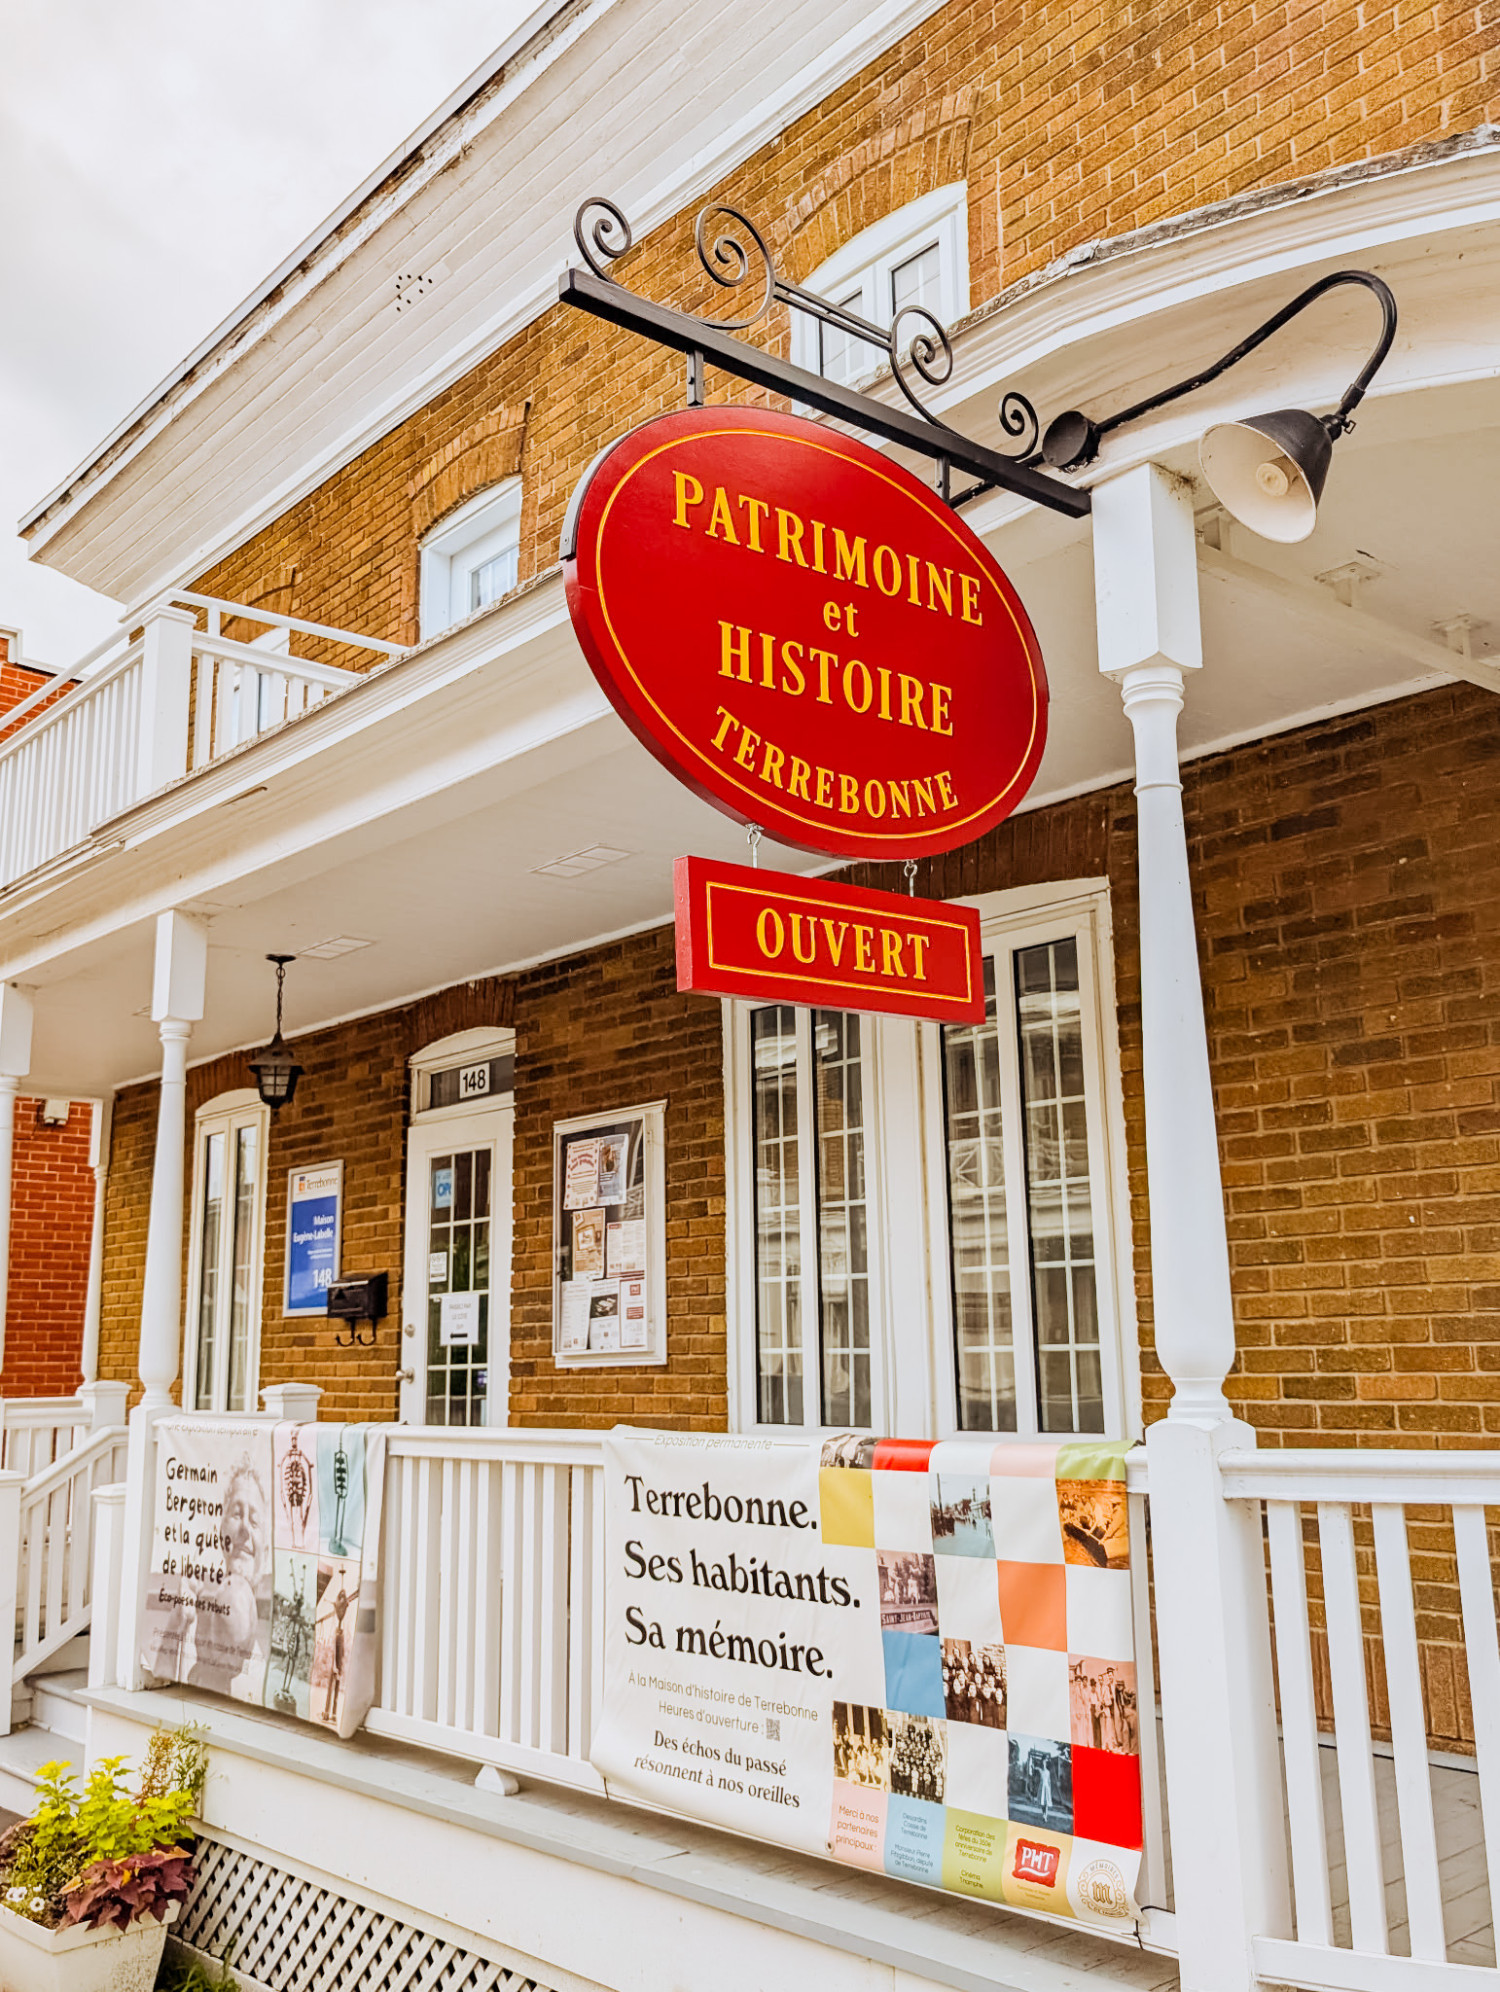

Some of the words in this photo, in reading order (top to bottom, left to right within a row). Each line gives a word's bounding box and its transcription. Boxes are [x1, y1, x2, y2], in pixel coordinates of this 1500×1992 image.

[672, 470, 983, 627] PATRIMOINE
[823, 601, 859, 638] et
[718, 620, 954, 737] HISTOIRE
[710, 706, 959, 819] TERREBONNE
[756, 907, 929, 981] OUVERT
[462, 1069, 486, 1092] 148
[313, 1215, 334, 1226] Maison
[313, 1268, 332, 1289] 148
[654, 1434, 704, 1448] Exposition
[704, 1437, 772, 1450] permanente
[166, 1457, 217, 1483] Germain
[166, 1486, 223, 1521] Bergeron
[624, 1474, 817, 1529] Terrebonne.
[165, 1526, 176, 1542] et
[180, 1522, 189, 1544] la
[195, 1525, 231, 1555] quête
[163, 1550, 176, 1575] de
[181, 1555, 223, 1584] liberté
[624, 1540, 683, 1583] Ses
[690, 1548, 860, 1608] habitants.
[208, 1598, 230, 1616] rebuts
[625, 1605, 665, 1649] Sa
[675, 1620, 833, 1679] mémoire.
[628, 1669, 635, 1684] À
[638, 1673, 646, 1686] la
[649, 1675, 683, 1694] Maison
[685, 1683, 735, 1704] d'histoire
[738, 1692, 751, 1707] de
[754, 1695, 818, 1721] Terrebonne
[659, 1700, 694, 1720] Heures
[696, 1708, 759, 1733] d'ouverture
[654, 1730, 678, 1751] Des
[682, 1737, 721, 1761] échos
[724, 1748, 741, 1766] du
[746, 1755, 787, 1777] passé
[634, 1755, 703, 1784] résonnent
[706, 1769, 714, 1787] à
[718, 1779, 744, 1795] nos
[748, 1783, 800, 1808] oreilles
[837, 1821, 878, 1838] partenaires
[839, 1805, 858, 1818] Merci
[865, 1814, 879, 1824] nos
[836, 1835, 873, 1851] principaux
